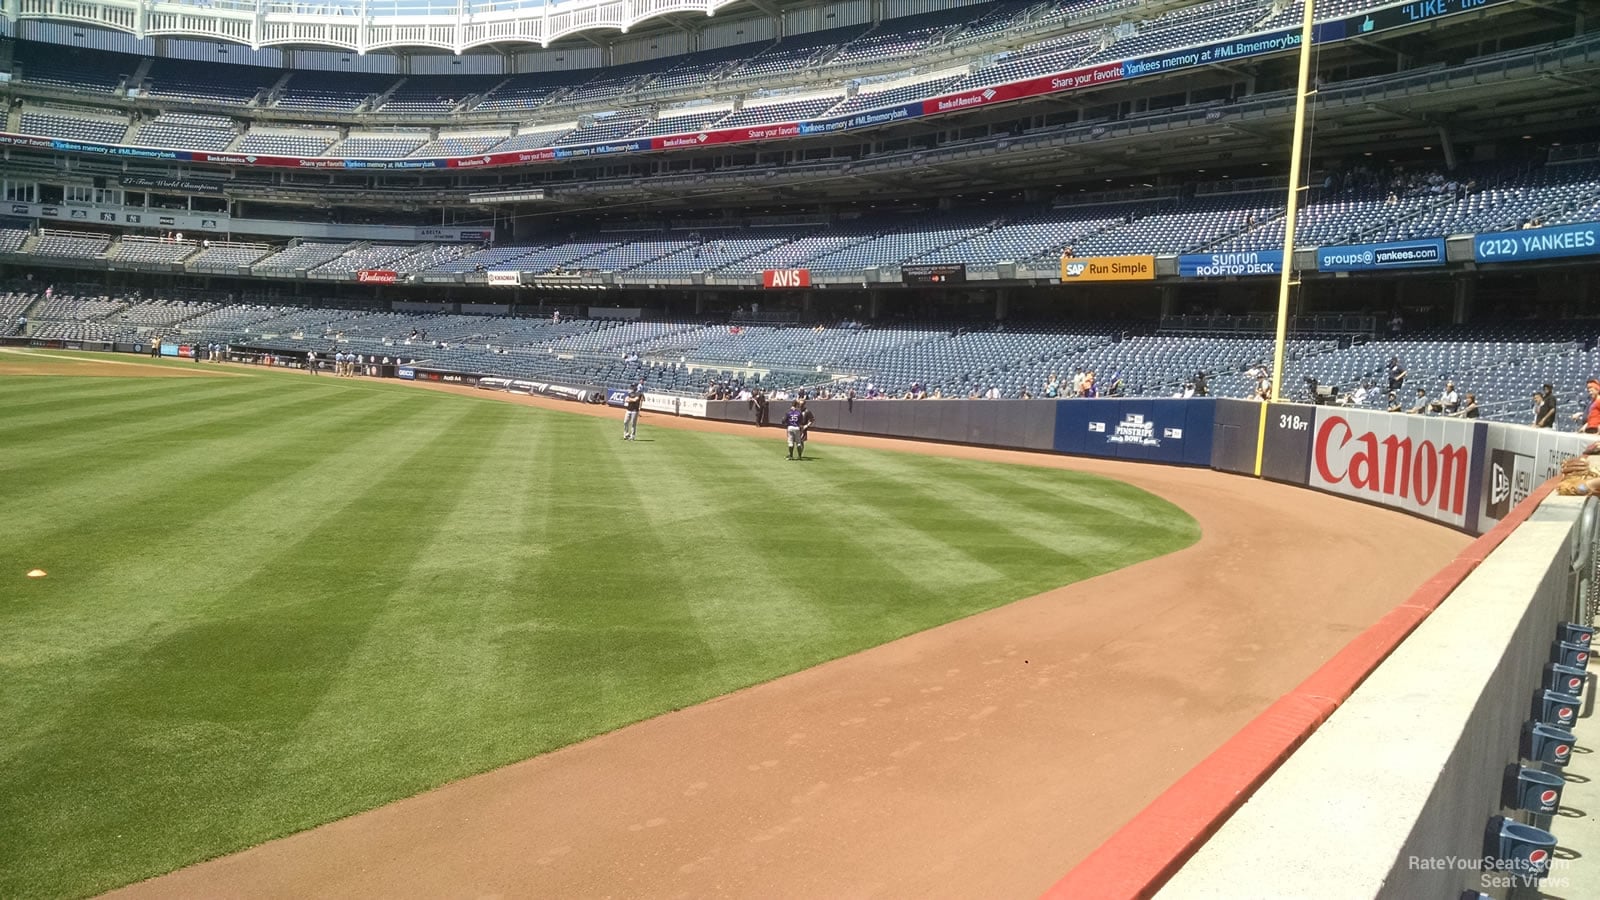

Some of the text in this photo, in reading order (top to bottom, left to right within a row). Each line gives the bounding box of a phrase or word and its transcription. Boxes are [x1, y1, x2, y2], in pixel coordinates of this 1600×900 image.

[1126, 34, 1314, 75] Yankees memory at #MLBmemorybak
[1051, 66, 1124, 88] Share your favorite
[938, 95, 982, 110] Bank of America
[801, 110, 908, 134] Yankees memory at #MLBmemorybank
[748, 124, 800, 139] Share your favorite
[56, 140, 82, 151] Yankees
[82, 145, 108, 155] memory
[663, 139, 675, 147] Bank
[678, 137, 697, 147] America
[299, 159, 315, 167] Share
[1479, 230, 1595, 257] (212) YANKEES
[1066, 264, 1085, 276] SAP
[1089, 261, 1148, 275] Run Simple
[1196, 263, 1274, 276] ROOFTOP DECK
[772, 270, 801, 287] AVIS
[610, 392, 625, 401] ACC
[1116, 427, 1153, 437] PINSTRIPE
[1124, 435, 1143, 443] BOWL
[1315, 415, 1468, 516] Canon
